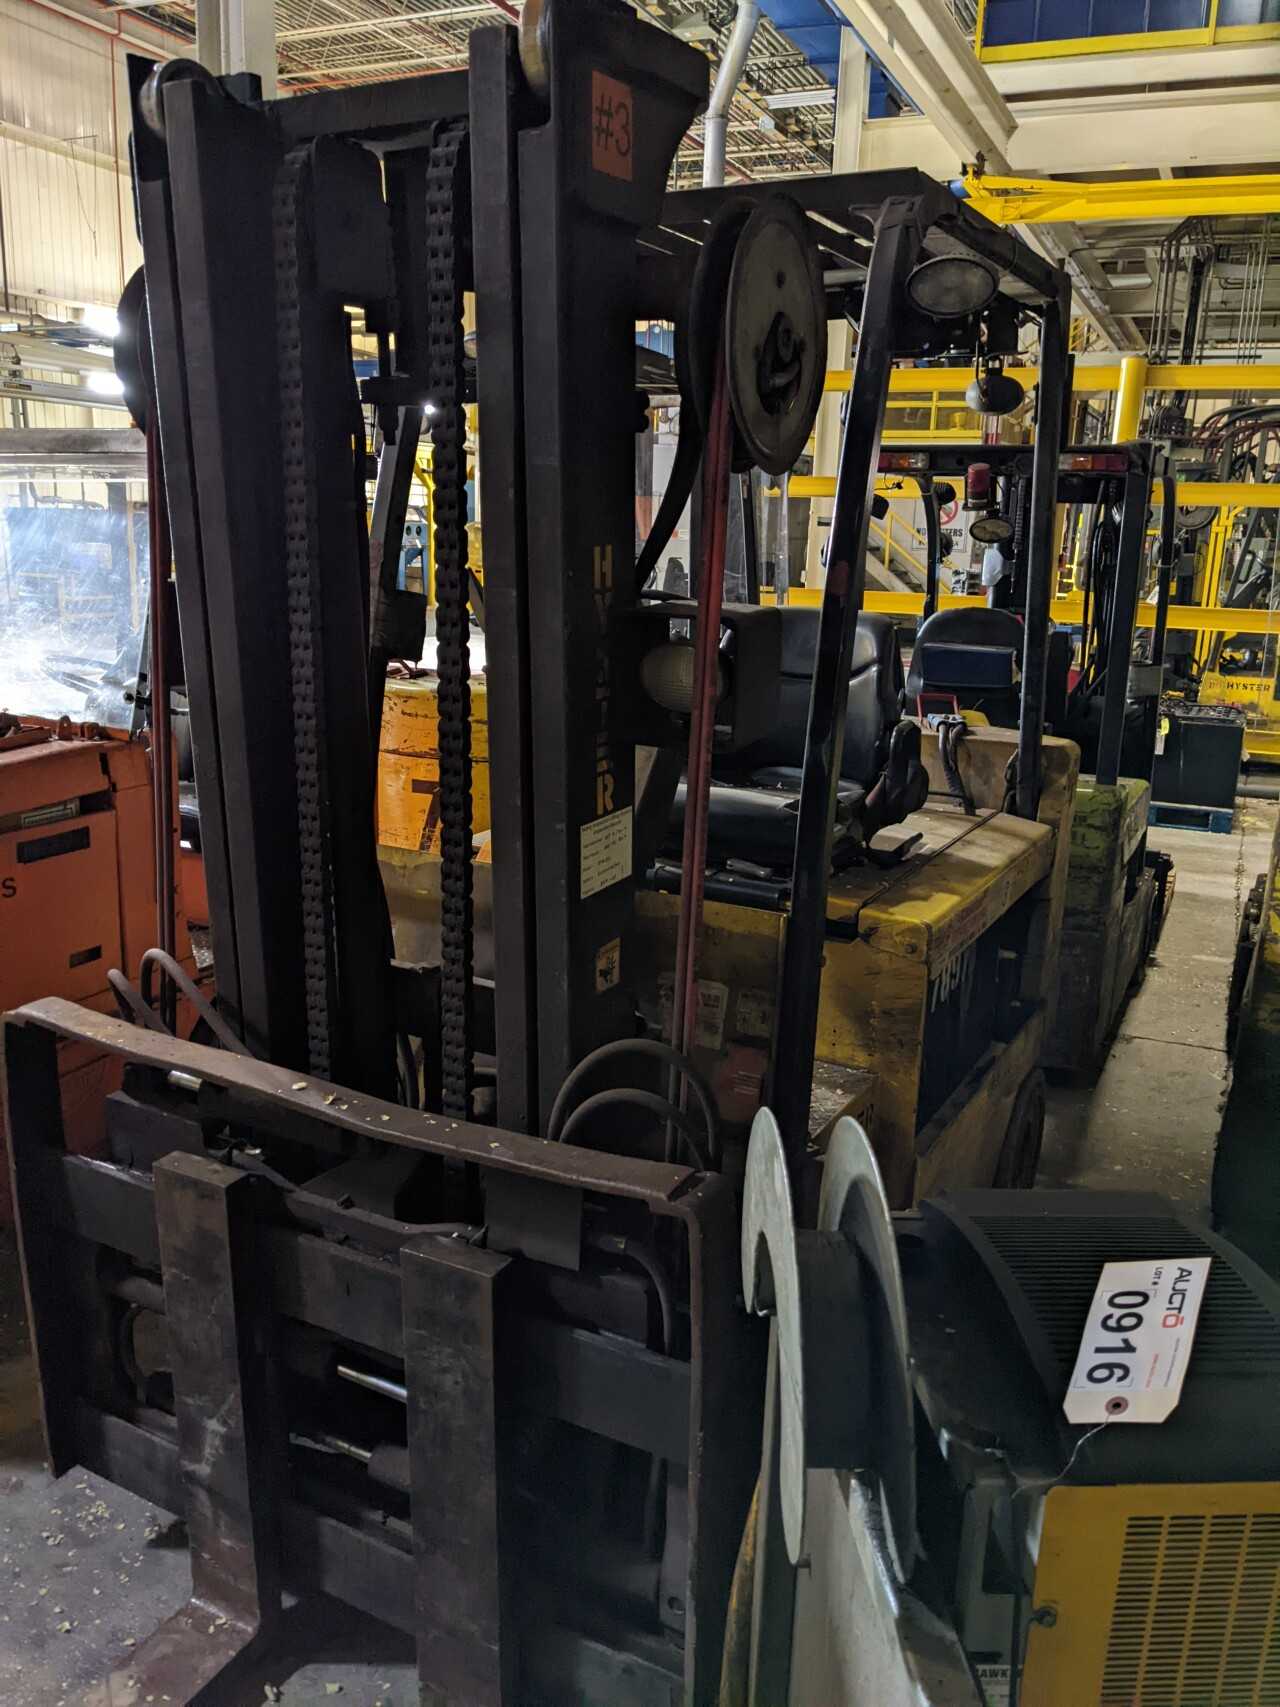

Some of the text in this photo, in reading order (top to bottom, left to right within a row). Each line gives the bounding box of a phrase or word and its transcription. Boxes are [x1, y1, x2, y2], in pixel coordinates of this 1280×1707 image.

[594, 93, 630, 156] #3
[1227, 682, 1271, 692] HYSTER
[1086, 1290, 1150, 1384] 0916
